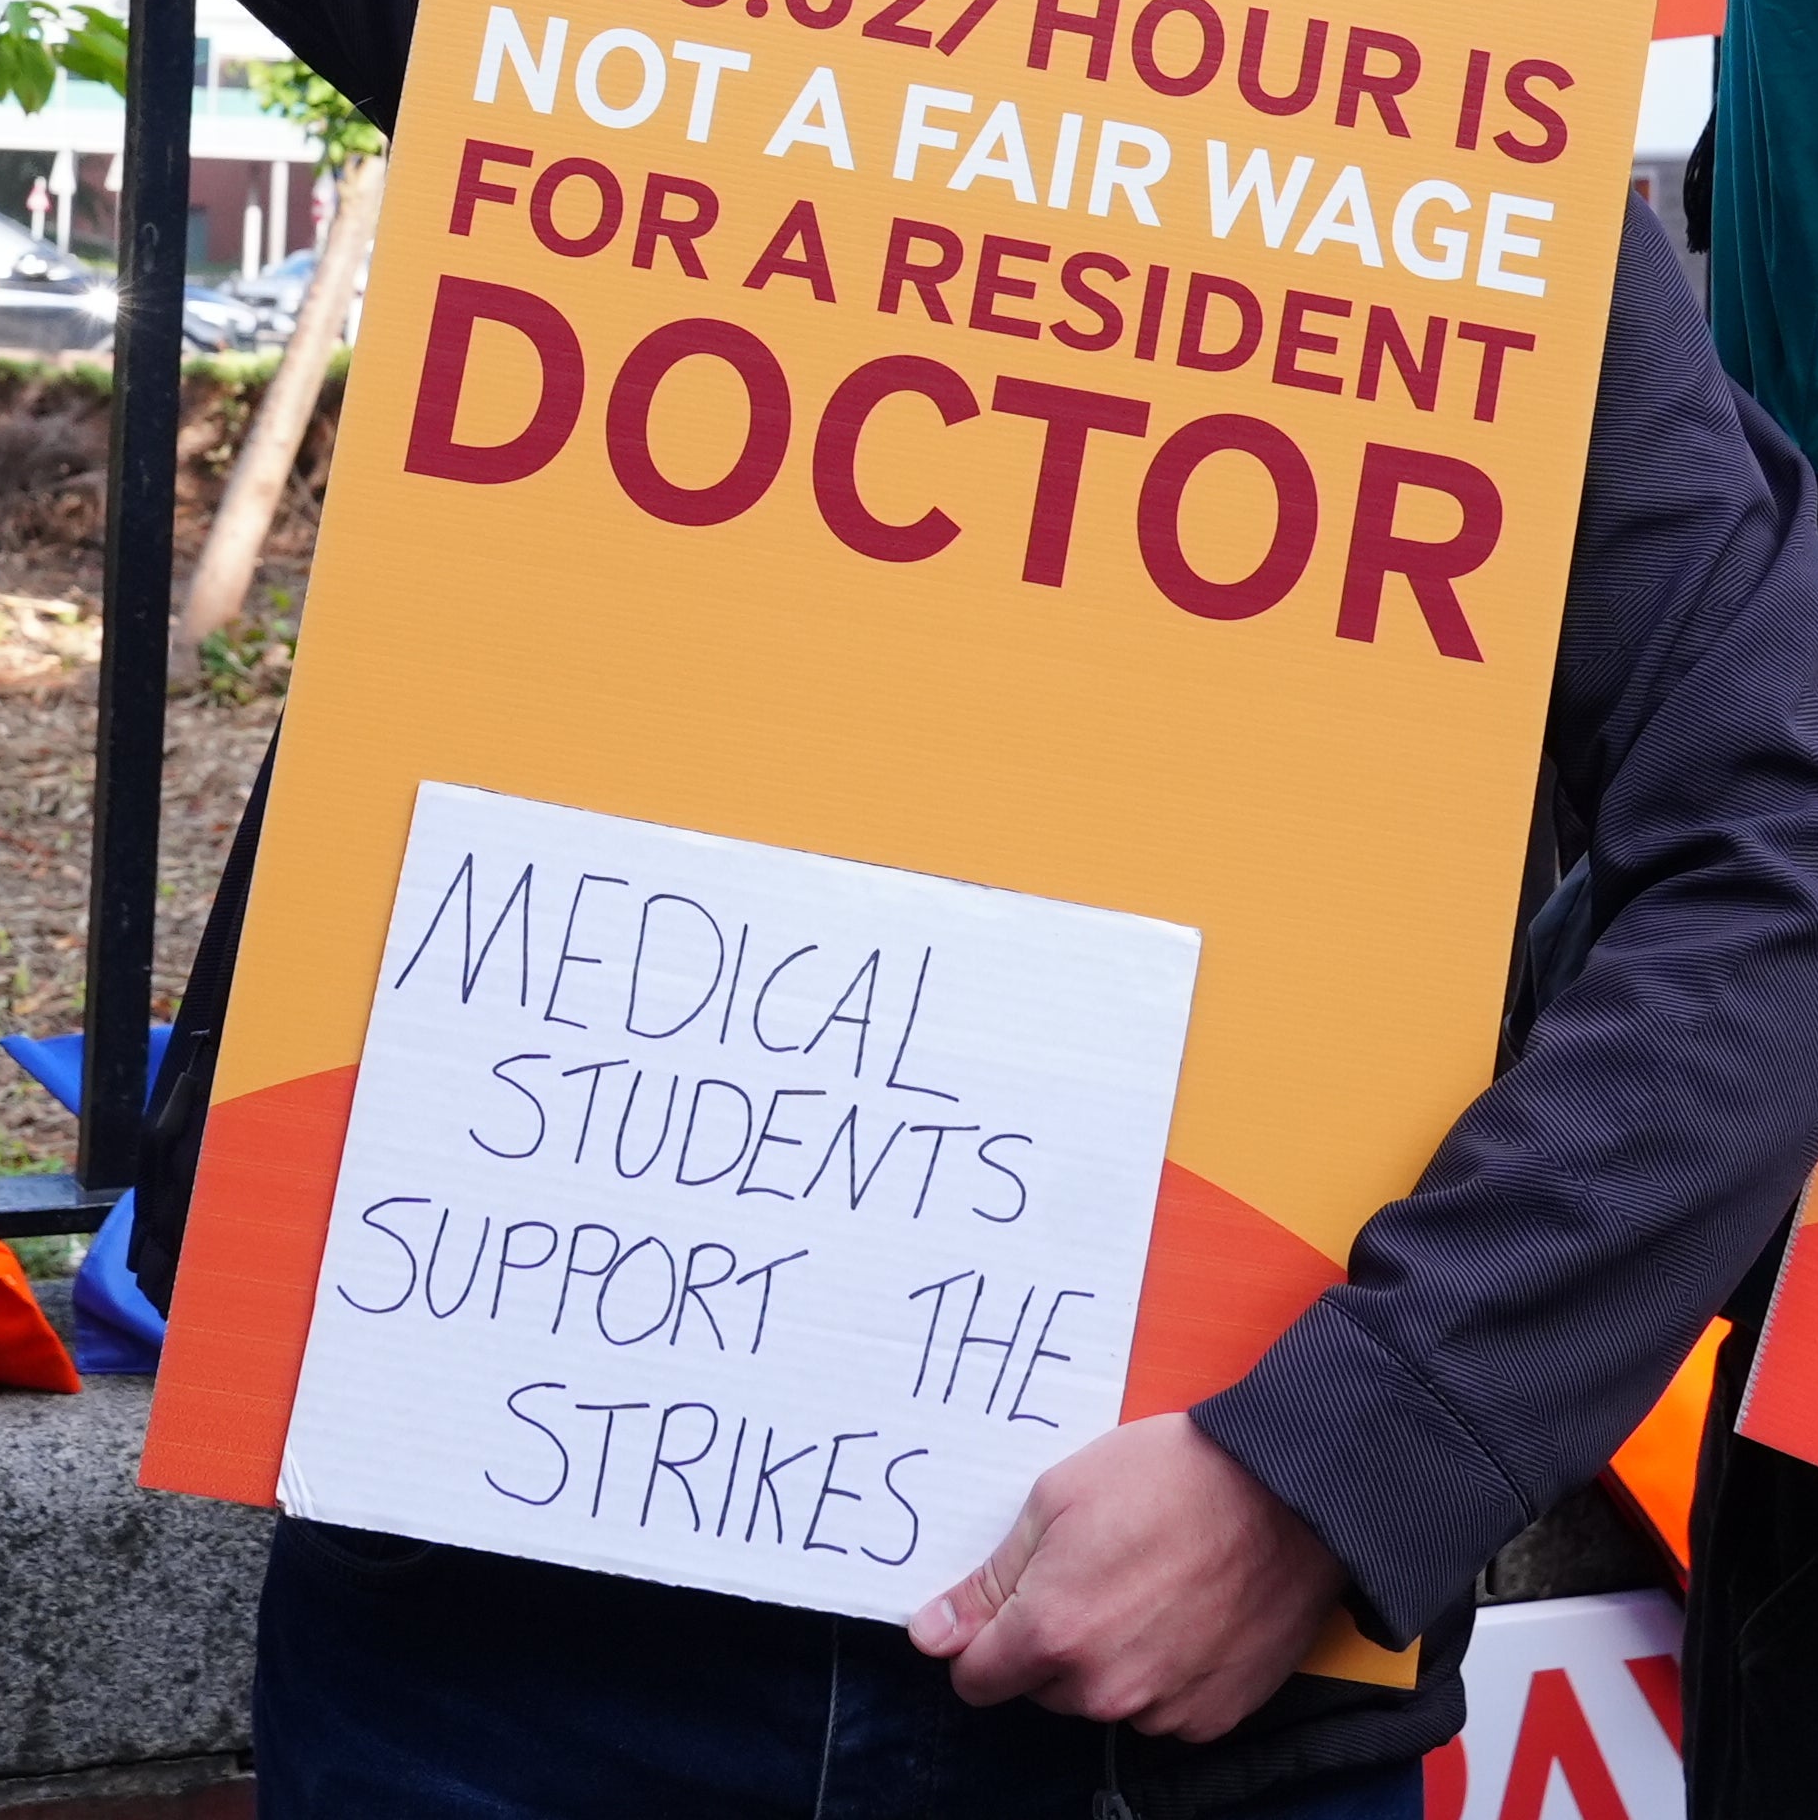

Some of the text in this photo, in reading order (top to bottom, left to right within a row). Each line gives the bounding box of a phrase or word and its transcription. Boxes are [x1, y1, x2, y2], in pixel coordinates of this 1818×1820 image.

[471, 5, 1557, 299] NOT A FAIR WAGE
[1456, 47, 1577, 165] IS
[446, 137, 1537, 424] FOR A RESIDENT
[403, 273, 1504, 665] DOCTOR
[394, 852, 960, 1102] MEDICAL
[469, 1053, 1033, 1224] STUDENTS
[335, 1196, 1096, 1429] SUPPORT THE
[484, 1380, 929, 1566] STRIKES
